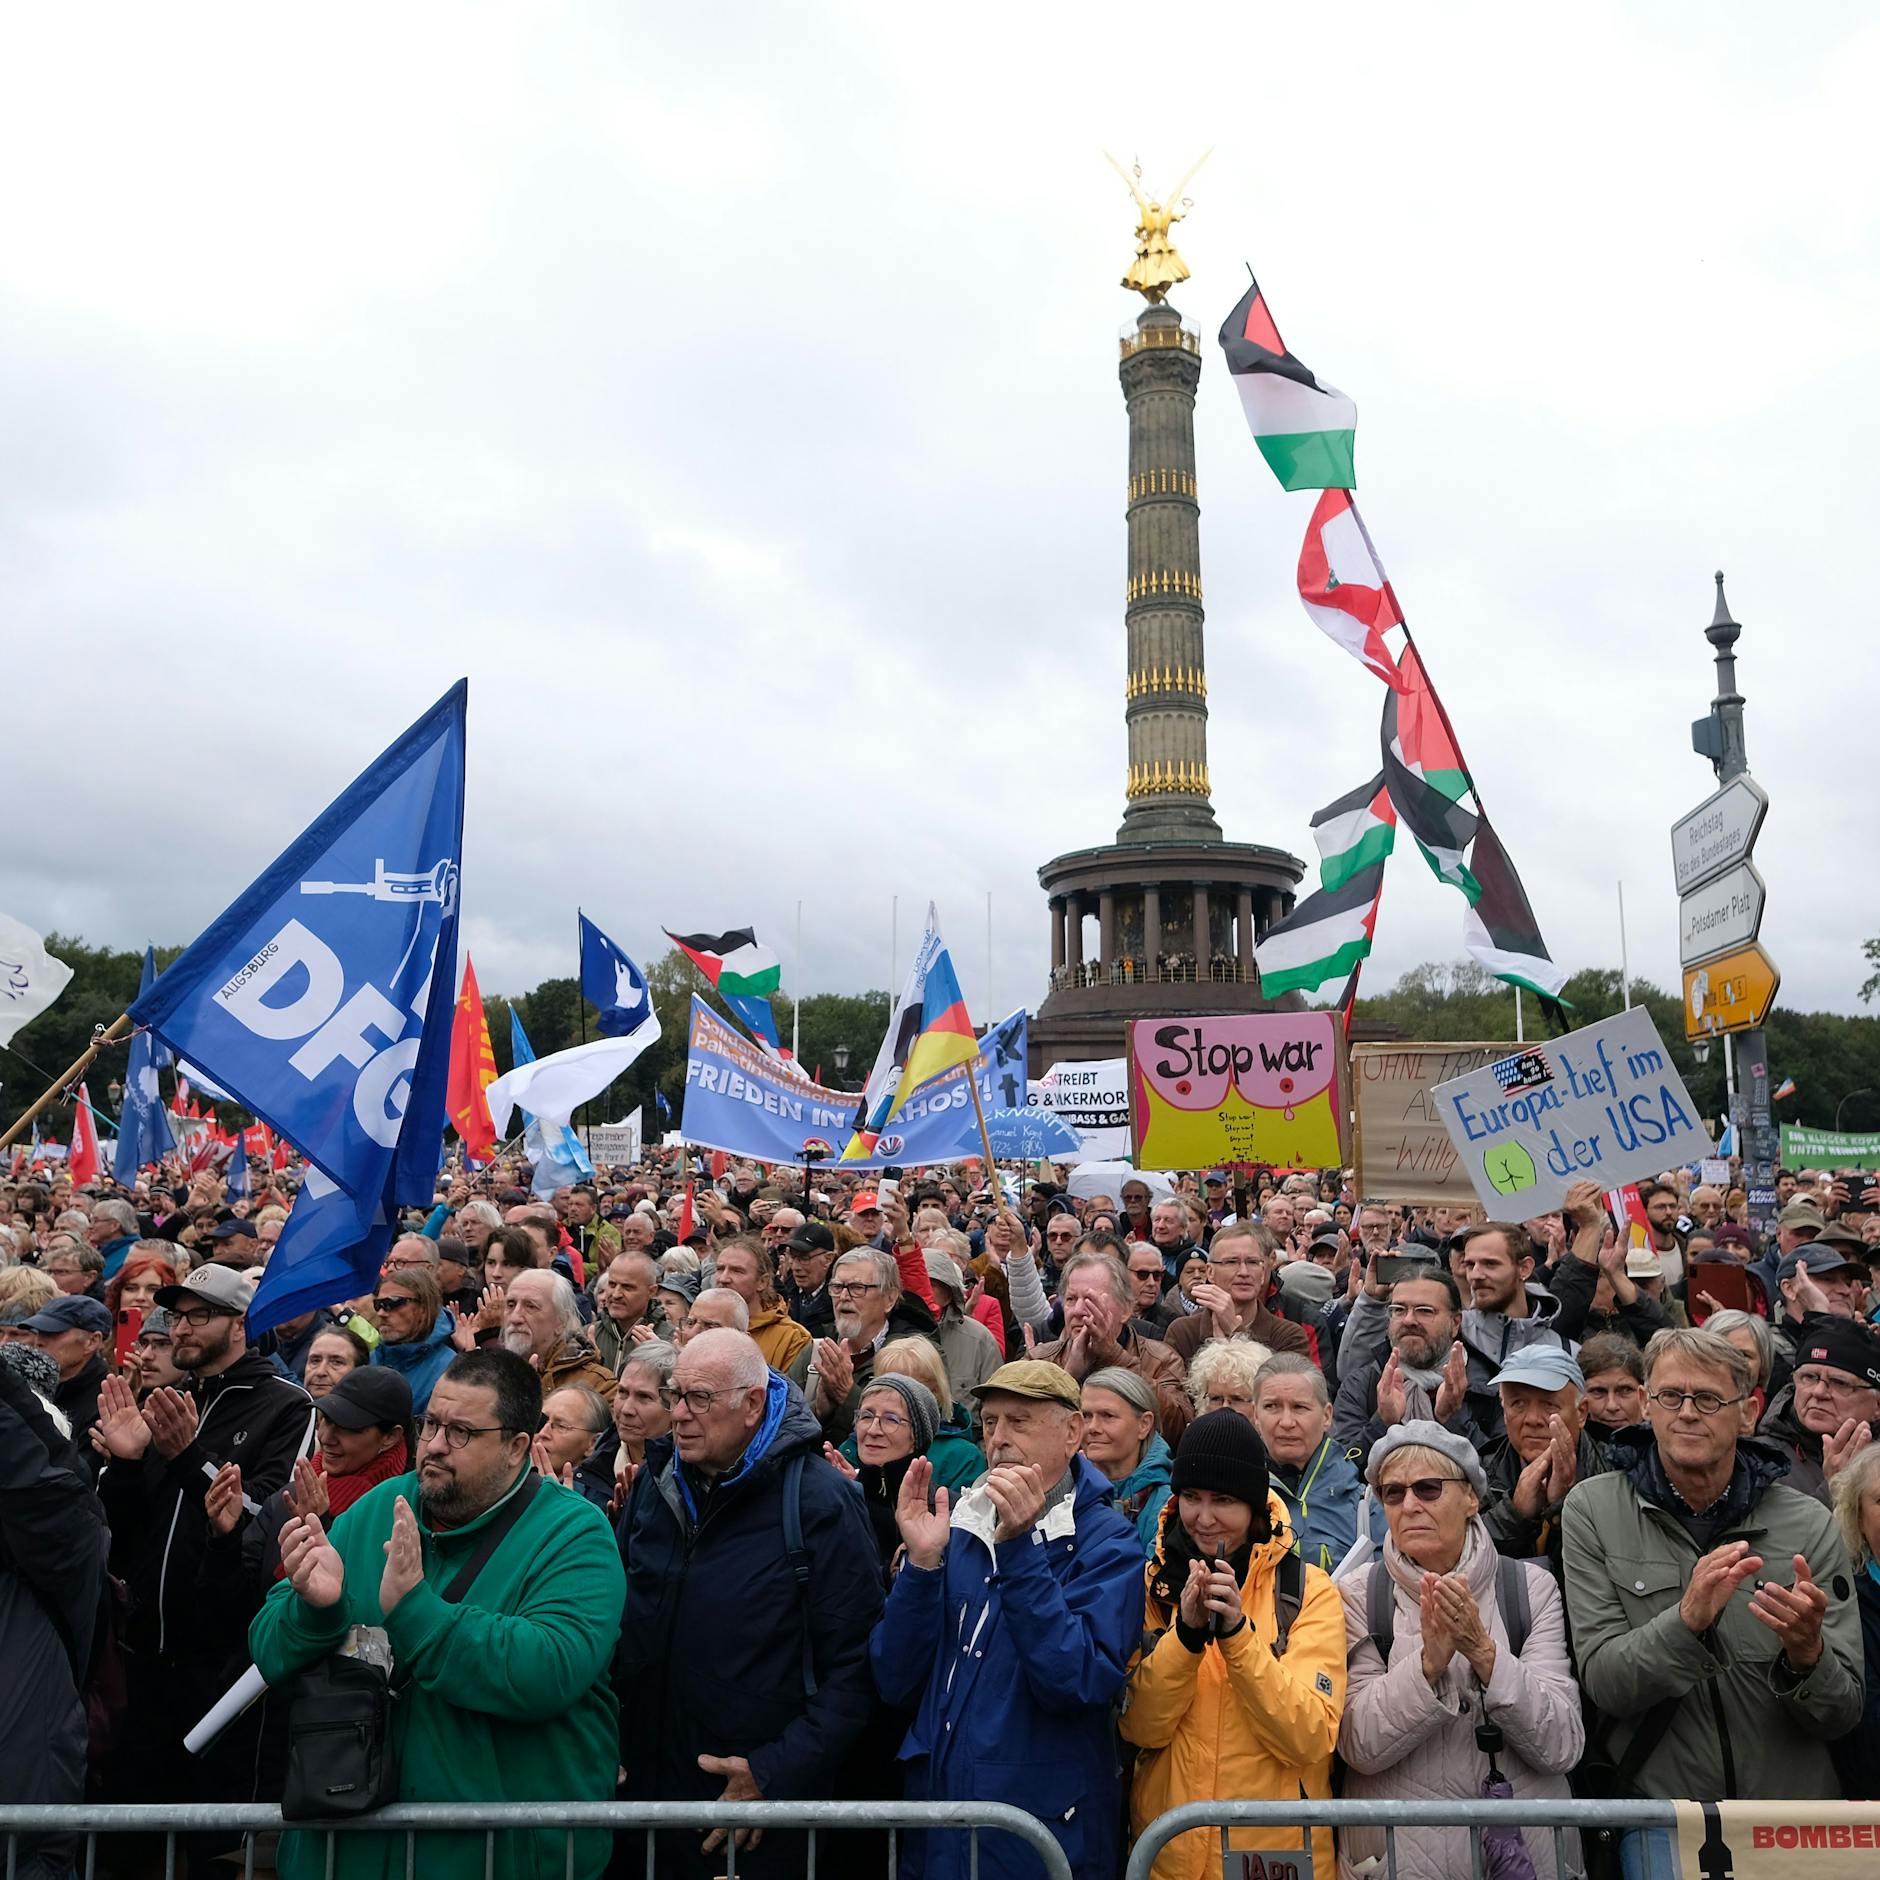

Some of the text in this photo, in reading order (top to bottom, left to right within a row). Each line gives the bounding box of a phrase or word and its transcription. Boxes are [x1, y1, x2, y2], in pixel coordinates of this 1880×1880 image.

[1689, 811, 1724, 847] Reichstag
[1701, 828, 1741, 864] Bundestages
[1691, 894, 1751, 935] Potsdamer Platz
[221, 942, 279, 1000] AUGSBURG
[1155, 1025, 1323, 1086] Stop war
[1363, 1053, 1427, 1081] OHNE
[1530, 1065, 1540, 1076] go
[1621, 1045, 1664, 1080] im
[685, 1058, 803, 1123] FRIEDEN
[811, 1107, 846, 1129] IN
[888, 1072, 993, 1126] AHOST!
[1057, 1072, 1098, 1086] TREIBT
[1043, 1093, 1053, 1106] &
[1218, 1111, 1237, 1122] Stop
[1402, 1088, 1442, 1122] AL
[1098, 1113, 1108, 1125] &
[1547, 1129, 1603, 1177] der
[1605, 1084, 1694, 1152] USA
[1788, 1144, 1825, 1155] UNTER
[1753, 1824, 1880, 1850] BOMBE
